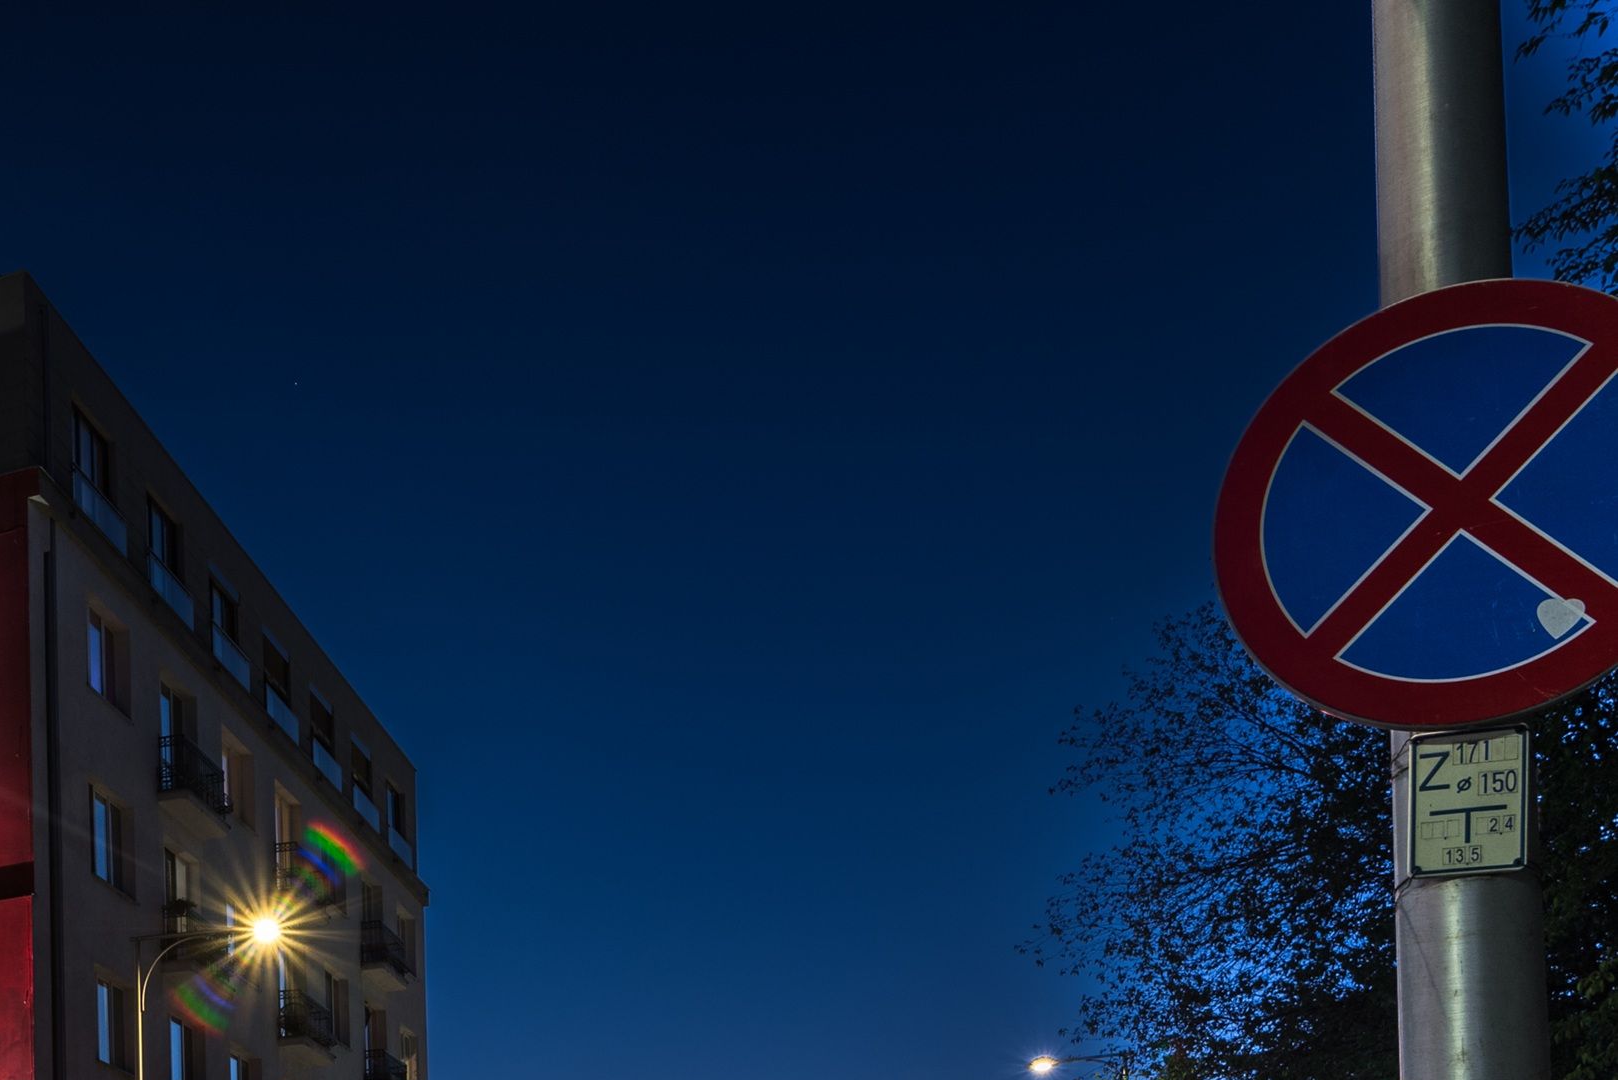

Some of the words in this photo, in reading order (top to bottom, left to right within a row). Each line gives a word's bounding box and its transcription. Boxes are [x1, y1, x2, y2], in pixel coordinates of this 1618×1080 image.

[1419, 751, 1450, 792] Z
[1456, 740, 1489, 764] 171
[1481, 769, 1517, 793] 150
